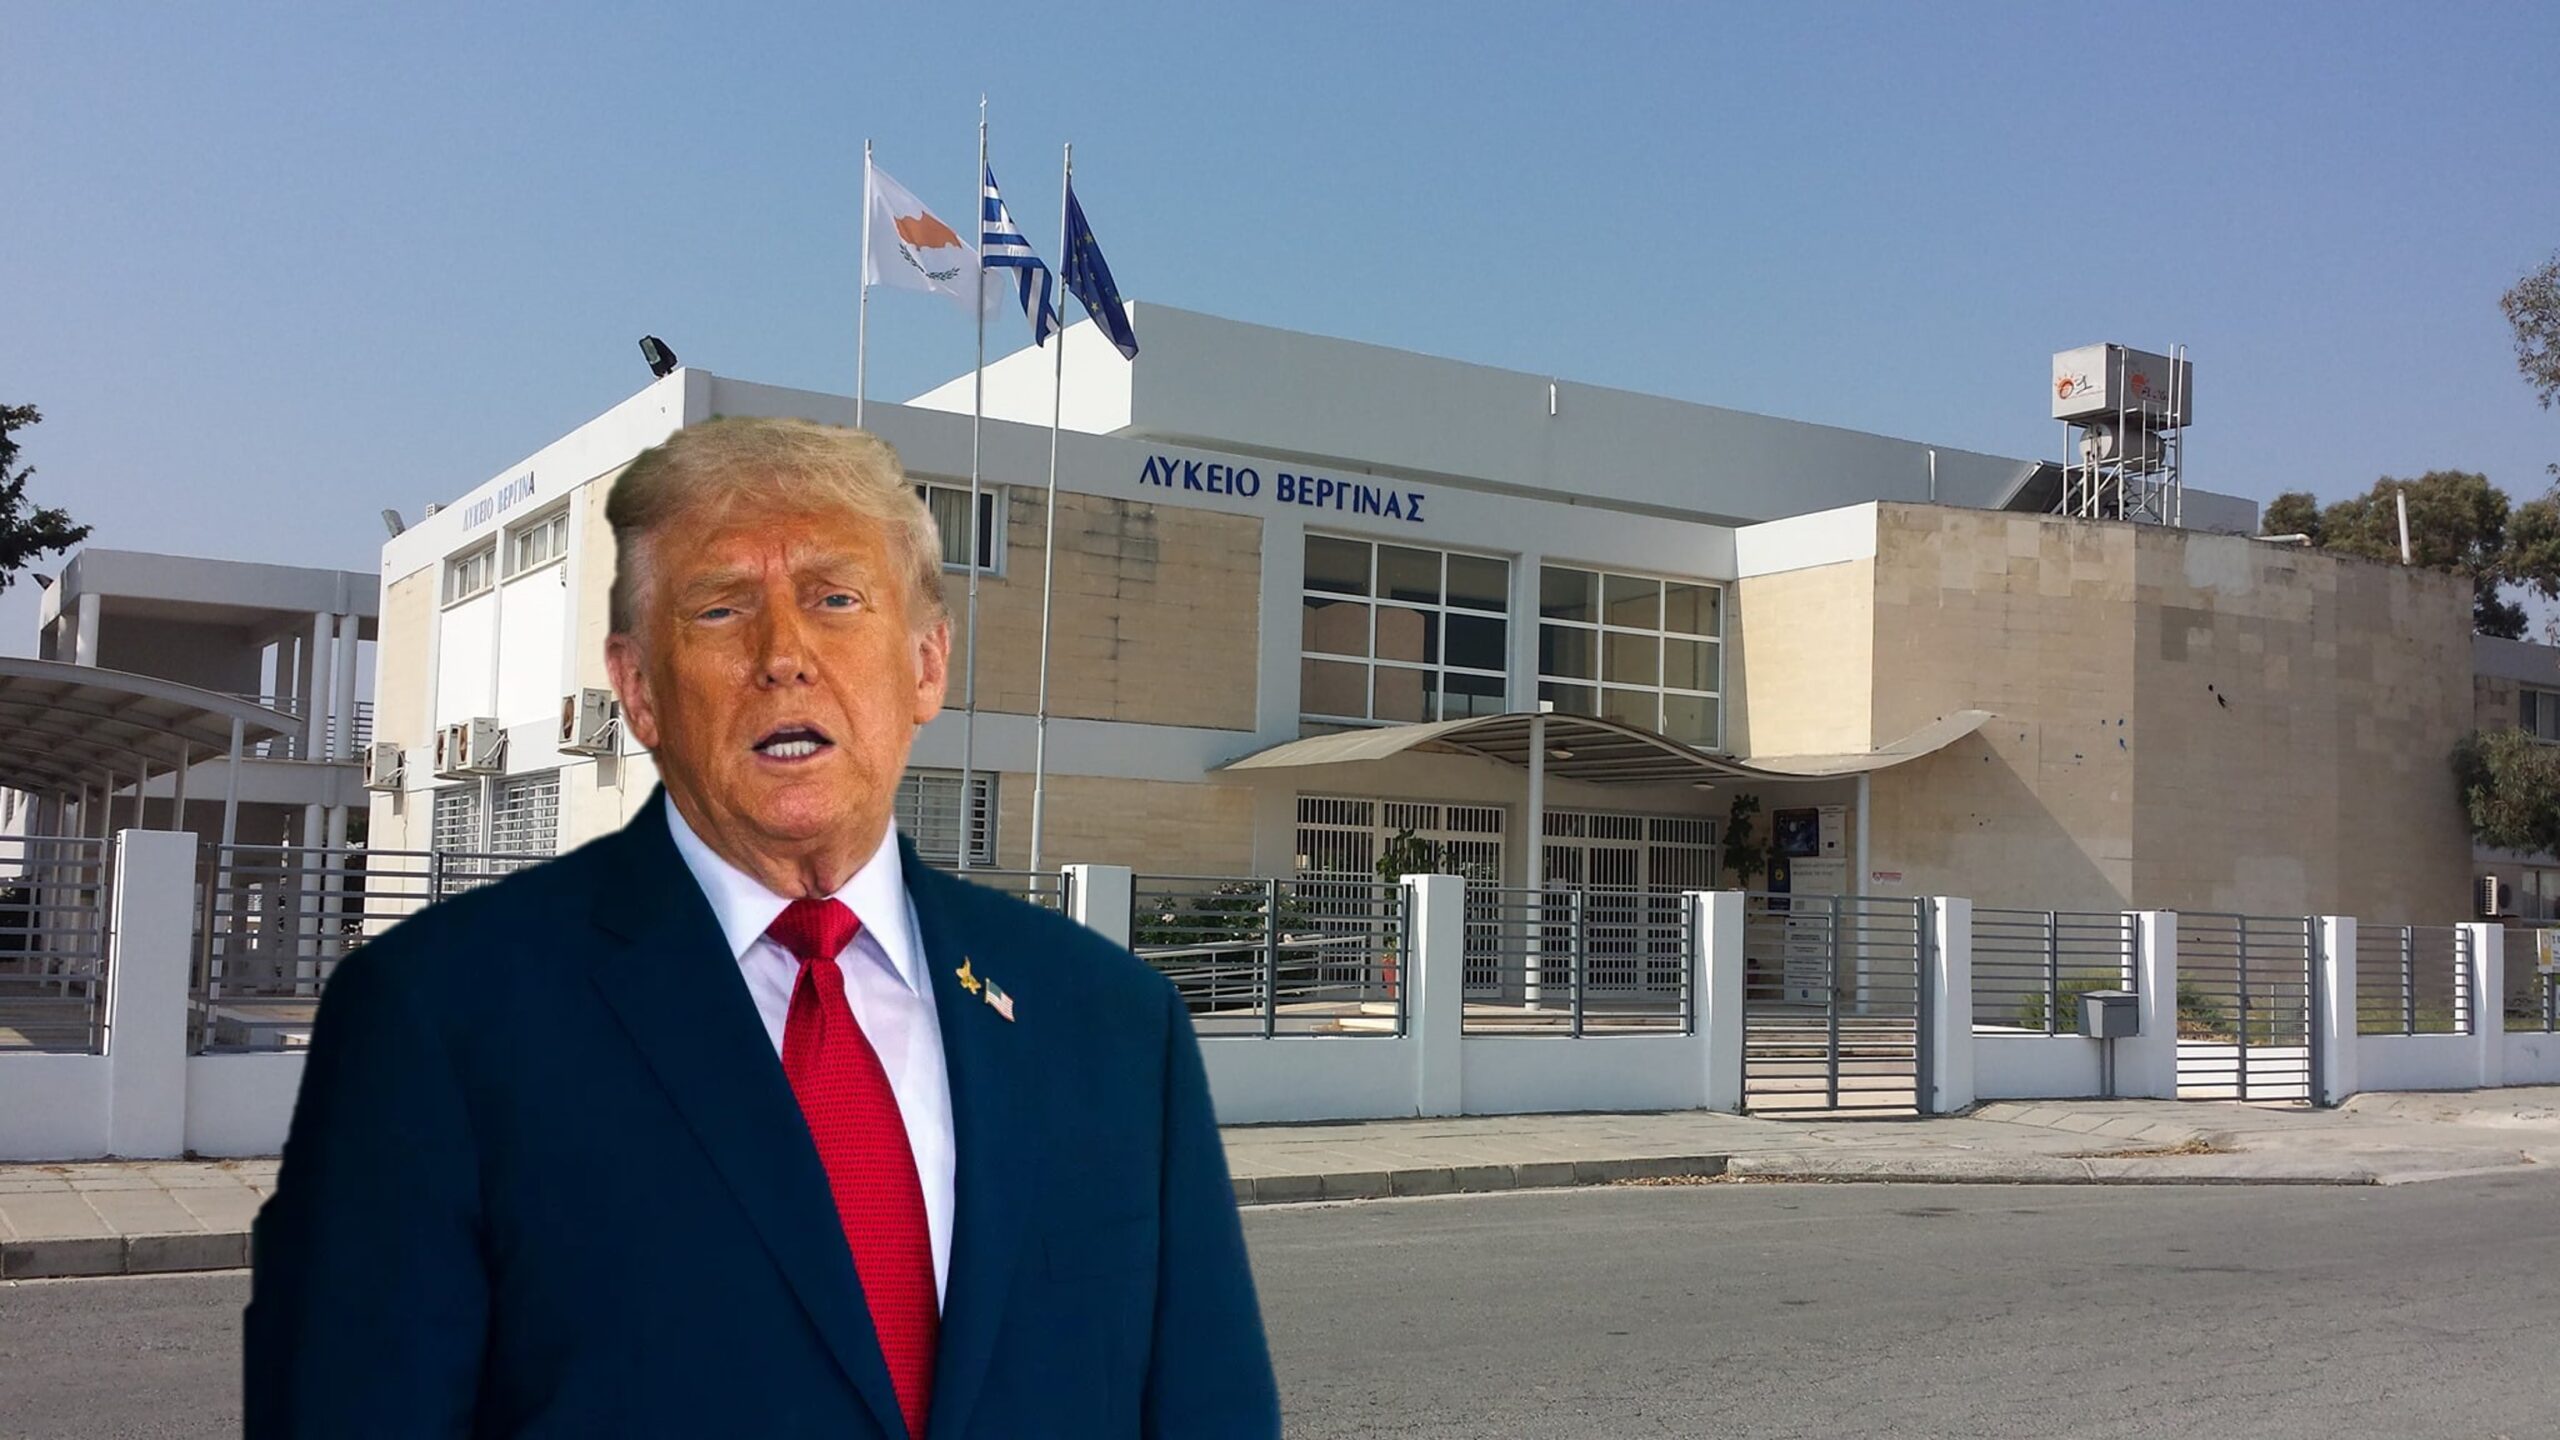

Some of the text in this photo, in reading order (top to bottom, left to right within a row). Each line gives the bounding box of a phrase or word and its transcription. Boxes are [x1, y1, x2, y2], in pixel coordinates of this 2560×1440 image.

[462, 496, 494, 532] ΛΥΚΕΙΟ
[1140, 455, 1425, 523] ΛΥΚΕΙΟ ΒΕΡΓΙΝΑΣ
